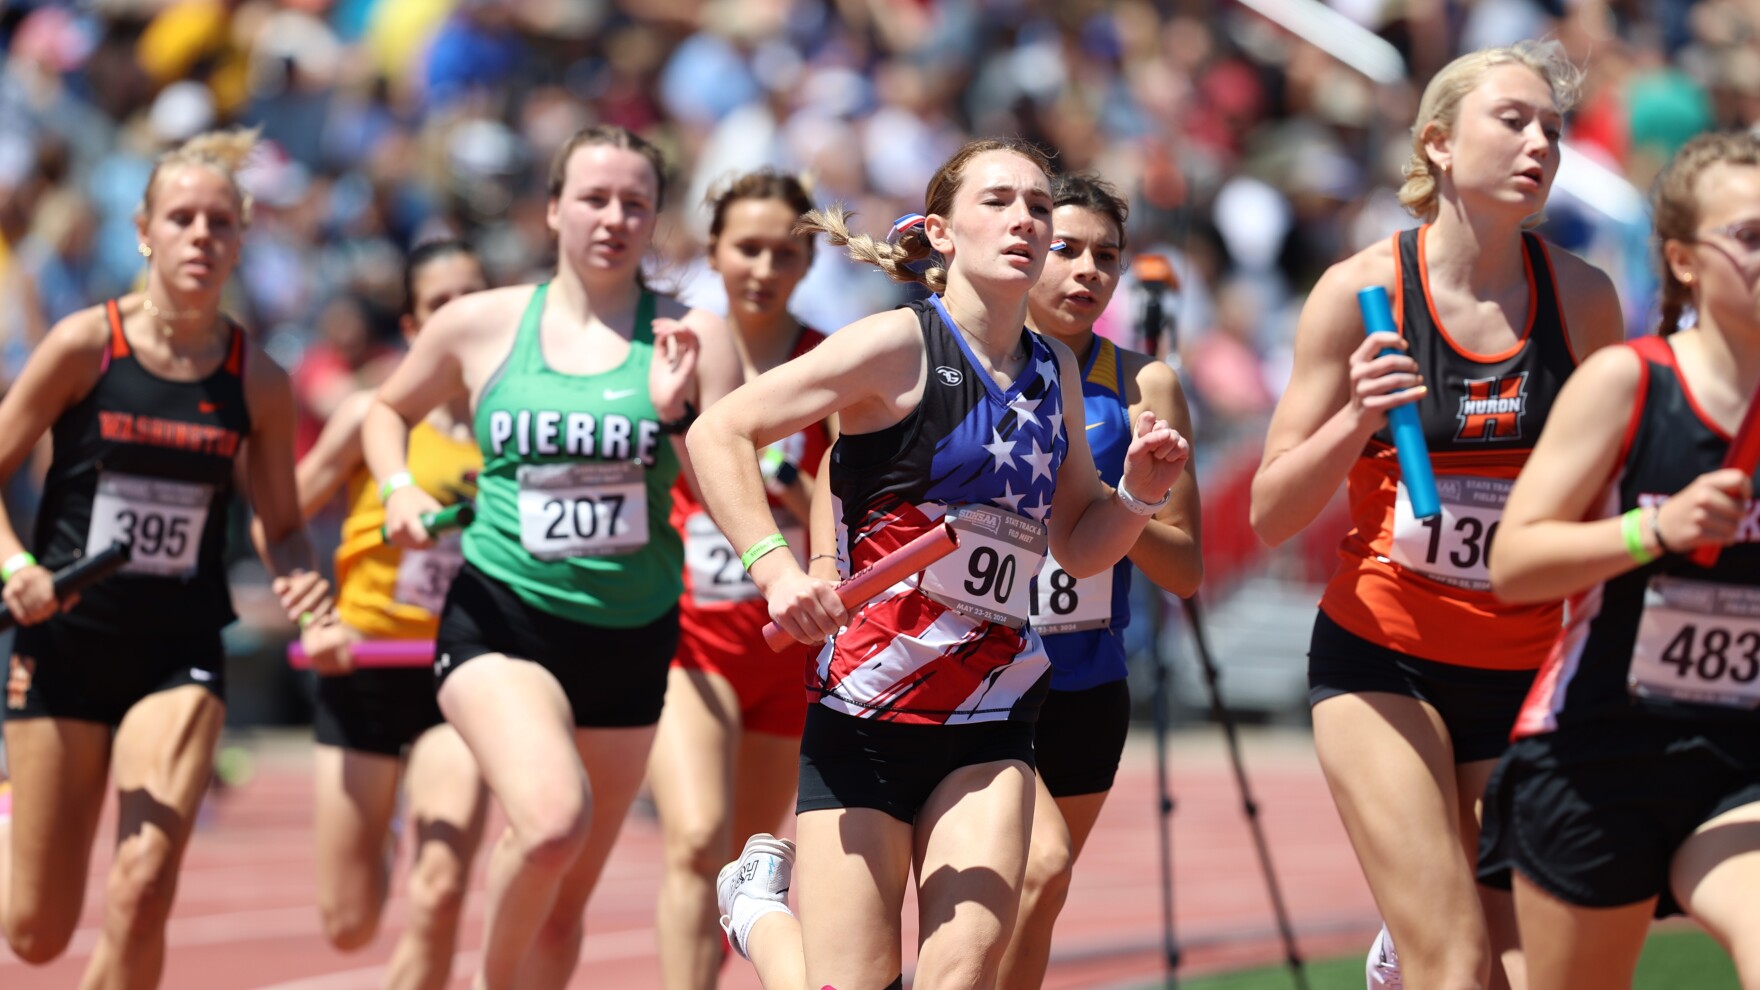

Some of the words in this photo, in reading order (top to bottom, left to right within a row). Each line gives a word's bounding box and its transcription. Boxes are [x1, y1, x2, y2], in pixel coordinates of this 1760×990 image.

[1464, 397, 1521, 415] HURON
[490, 410, 660, 466] PIERRE
[1493, 482, 1510, 492] TRA
[116, 509, 190, 558] 395
[543, 493, 627, 540] 207
[958, 509, 997, 527] SDHSAA
[1019, 521, 1037, 534] TRACK
[1018, 533, 1034, 544] MEET
[1421, 515, 1500, 568] 13
[709, 545, 752, 585] 2
[963, 546, 1016, 604] 90
[956, 603, 974, 613] MAY
[993, 613, 1007, 623] 2024
[1660, 623, 1760, 685] 483
